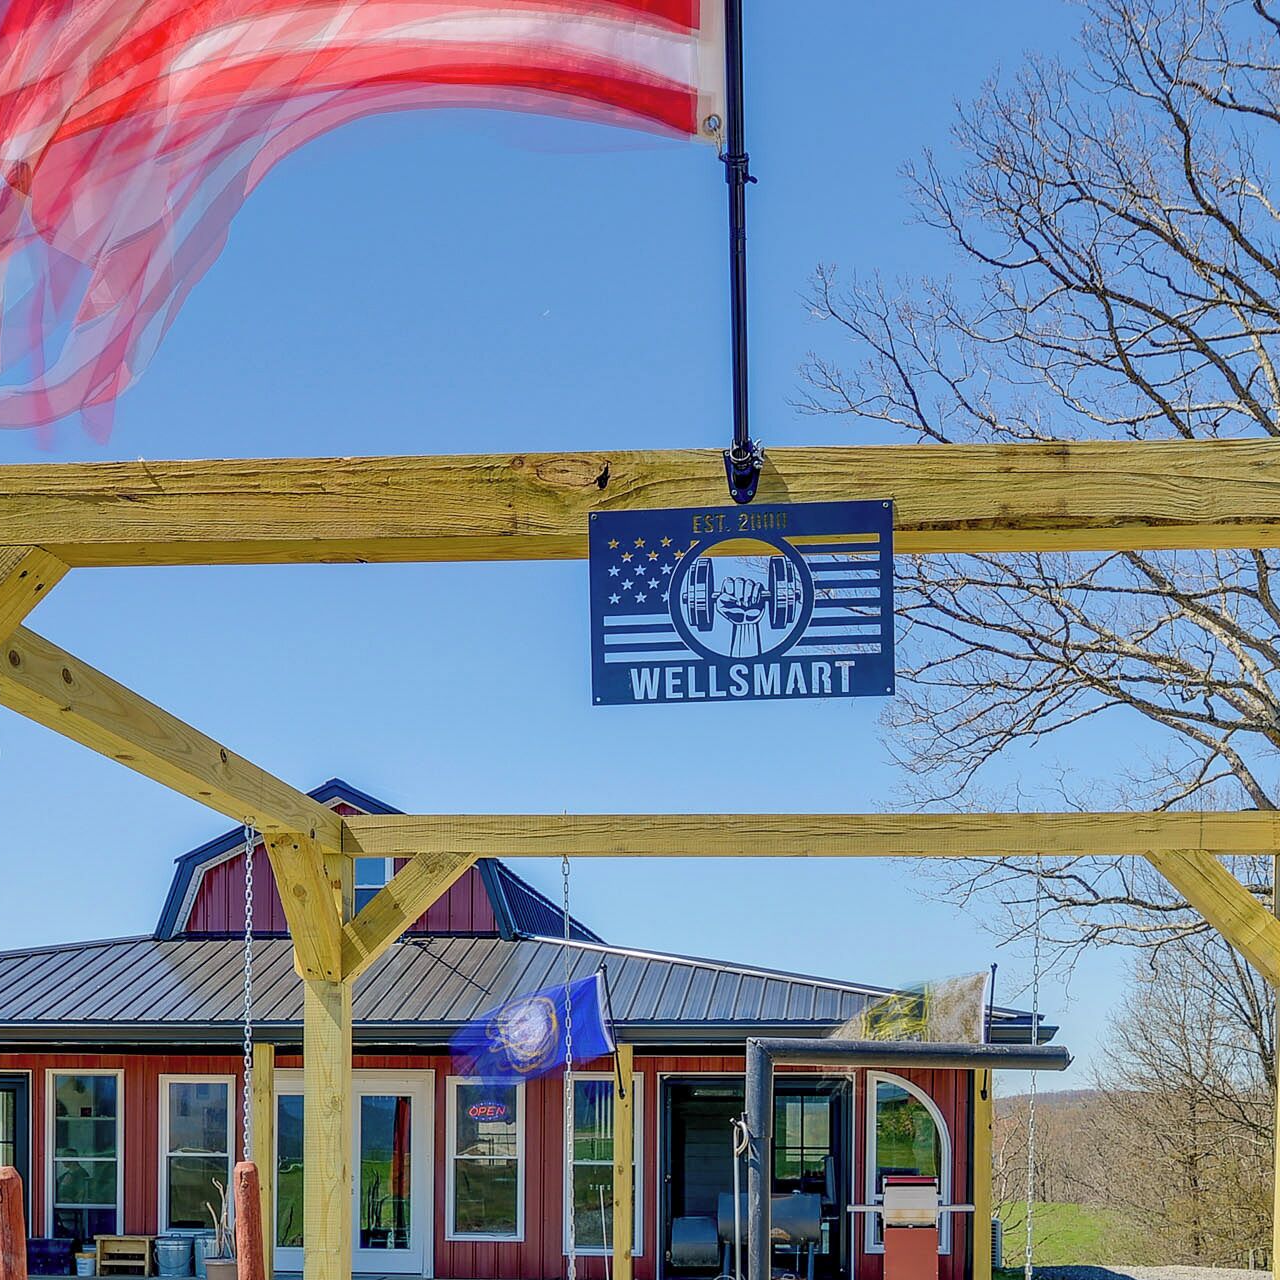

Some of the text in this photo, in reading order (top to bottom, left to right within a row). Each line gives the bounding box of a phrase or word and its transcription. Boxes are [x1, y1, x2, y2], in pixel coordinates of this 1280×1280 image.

[693, 513, 731, 533] EST.
[630, 661, 856, 700] WELLSMART
[468, 1106, 506, 1116] OPEN
